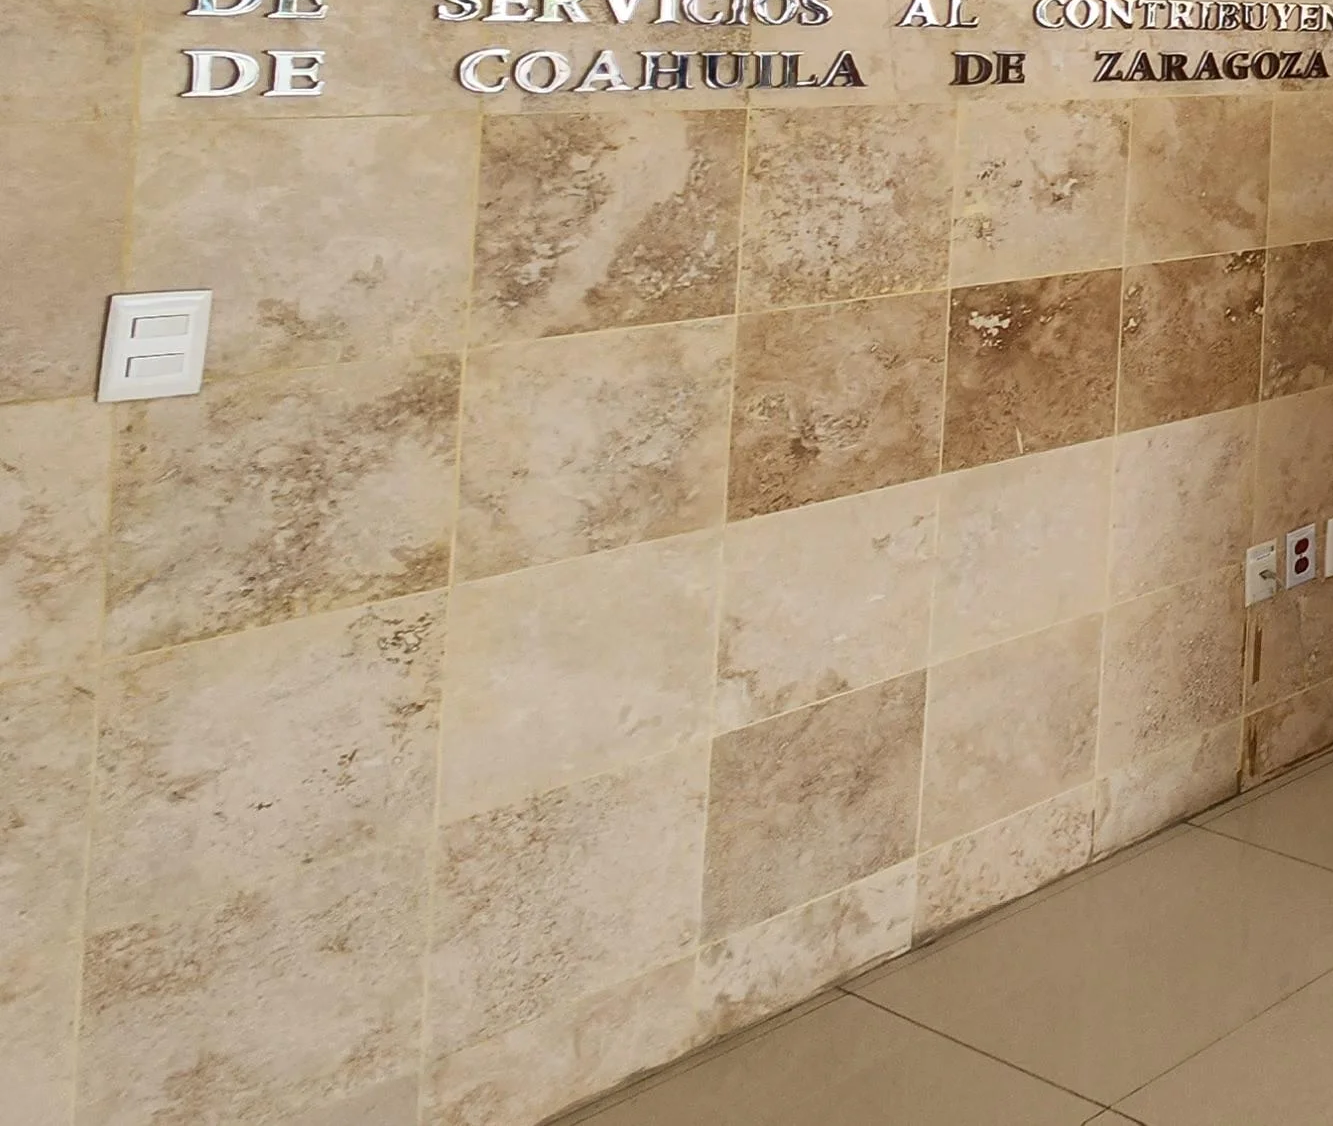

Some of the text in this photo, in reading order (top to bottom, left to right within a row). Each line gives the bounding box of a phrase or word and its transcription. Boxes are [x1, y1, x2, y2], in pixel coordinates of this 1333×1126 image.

[179, 48, 326, 98] DE
[457, 48, 868, 94] COAHUILA
[949, 50, 1027, 86] DE
[1092, 49, 1330, 83] ZARAGOZA
